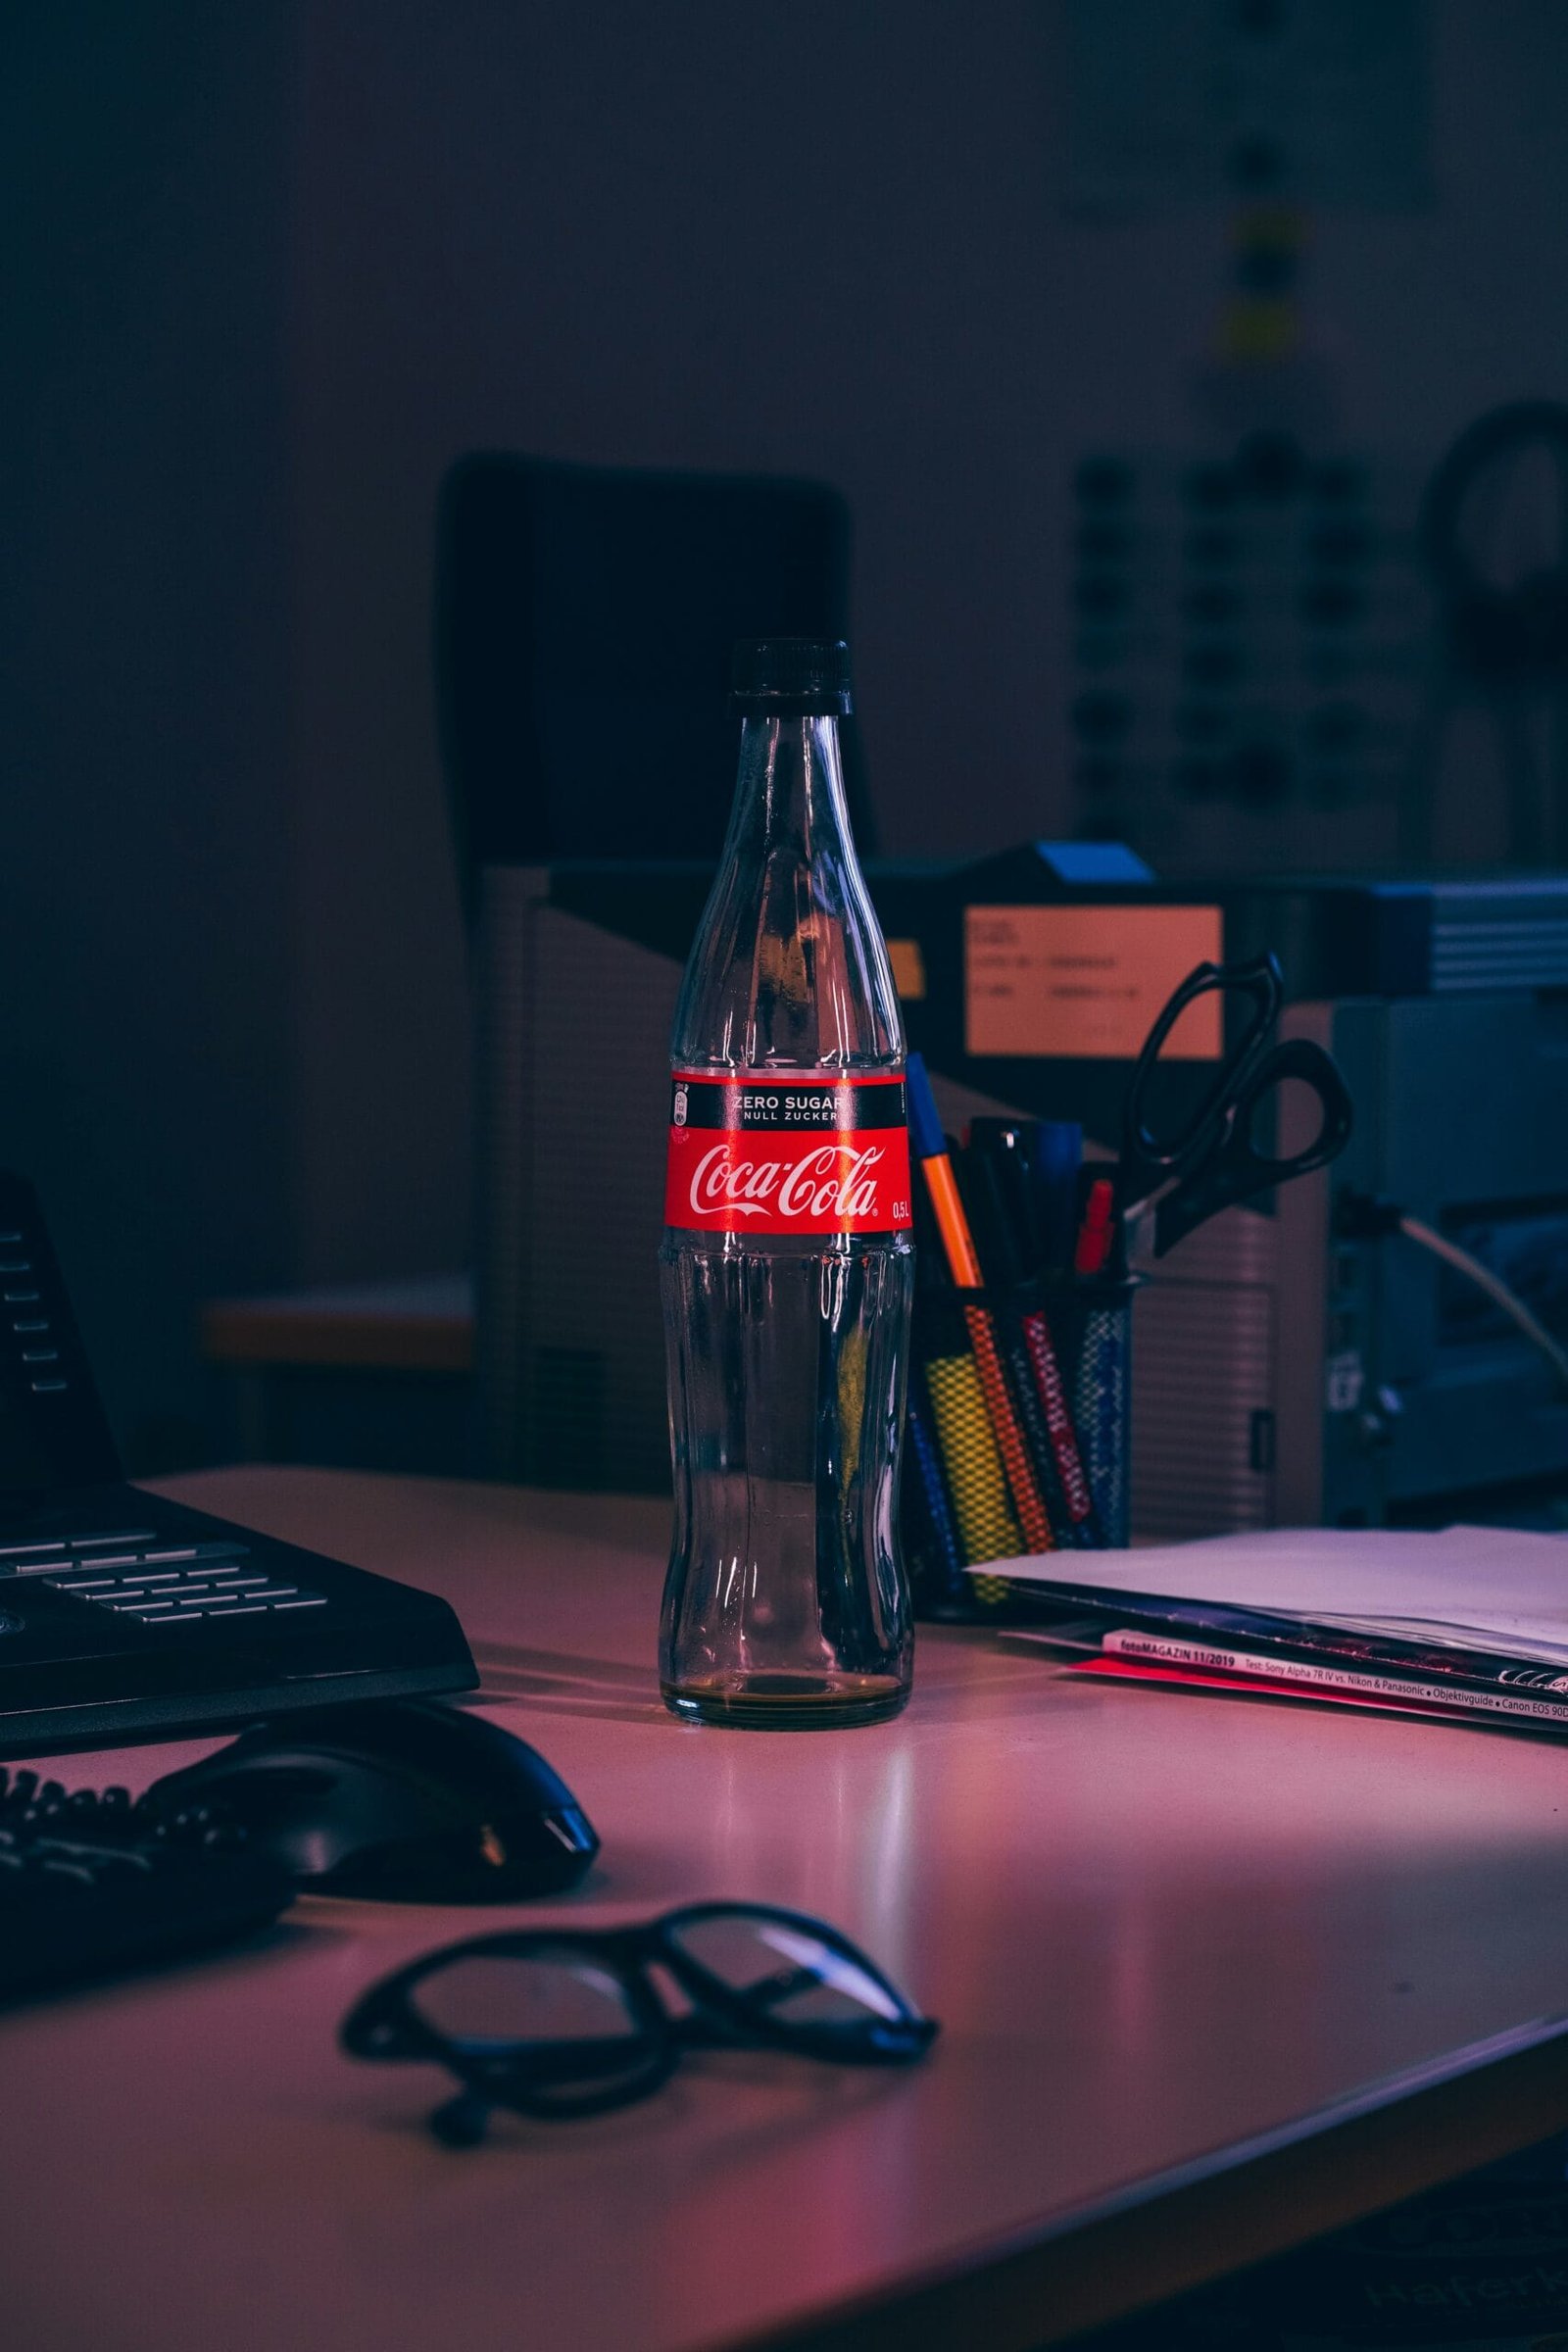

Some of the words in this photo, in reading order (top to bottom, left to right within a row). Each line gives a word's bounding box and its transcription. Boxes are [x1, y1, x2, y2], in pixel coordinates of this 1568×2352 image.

[732, 1097, 779, 1109] ZERO
[744, 1111, 778, 1120] NULL
[690, 1144, 886, 1217] Coca-Cola
[1121, 1639, 1191, 1660] fotoMAGAZIN
[1194, 1651, 1235, 1667] 11/2019
[1246, 1658, 1262, 1671] Test:
[1265, 1662, 1284, 1676] Sony
[1287, 1666, 1310, 1678] Alpha
[1325, 1671, 1334, 1681] IV
[1348, 1675, 1372, 1688] Nikon
[1374, 1679, 1381, 1689] &
[1382, 1680, 1425, 1696] Panasonic
[1433, 1688, 1494, 1706] Objektivguide
[1501, 1698, 1530, 1711] Canon
[1533, 1703, 1549, 1715] EOS
